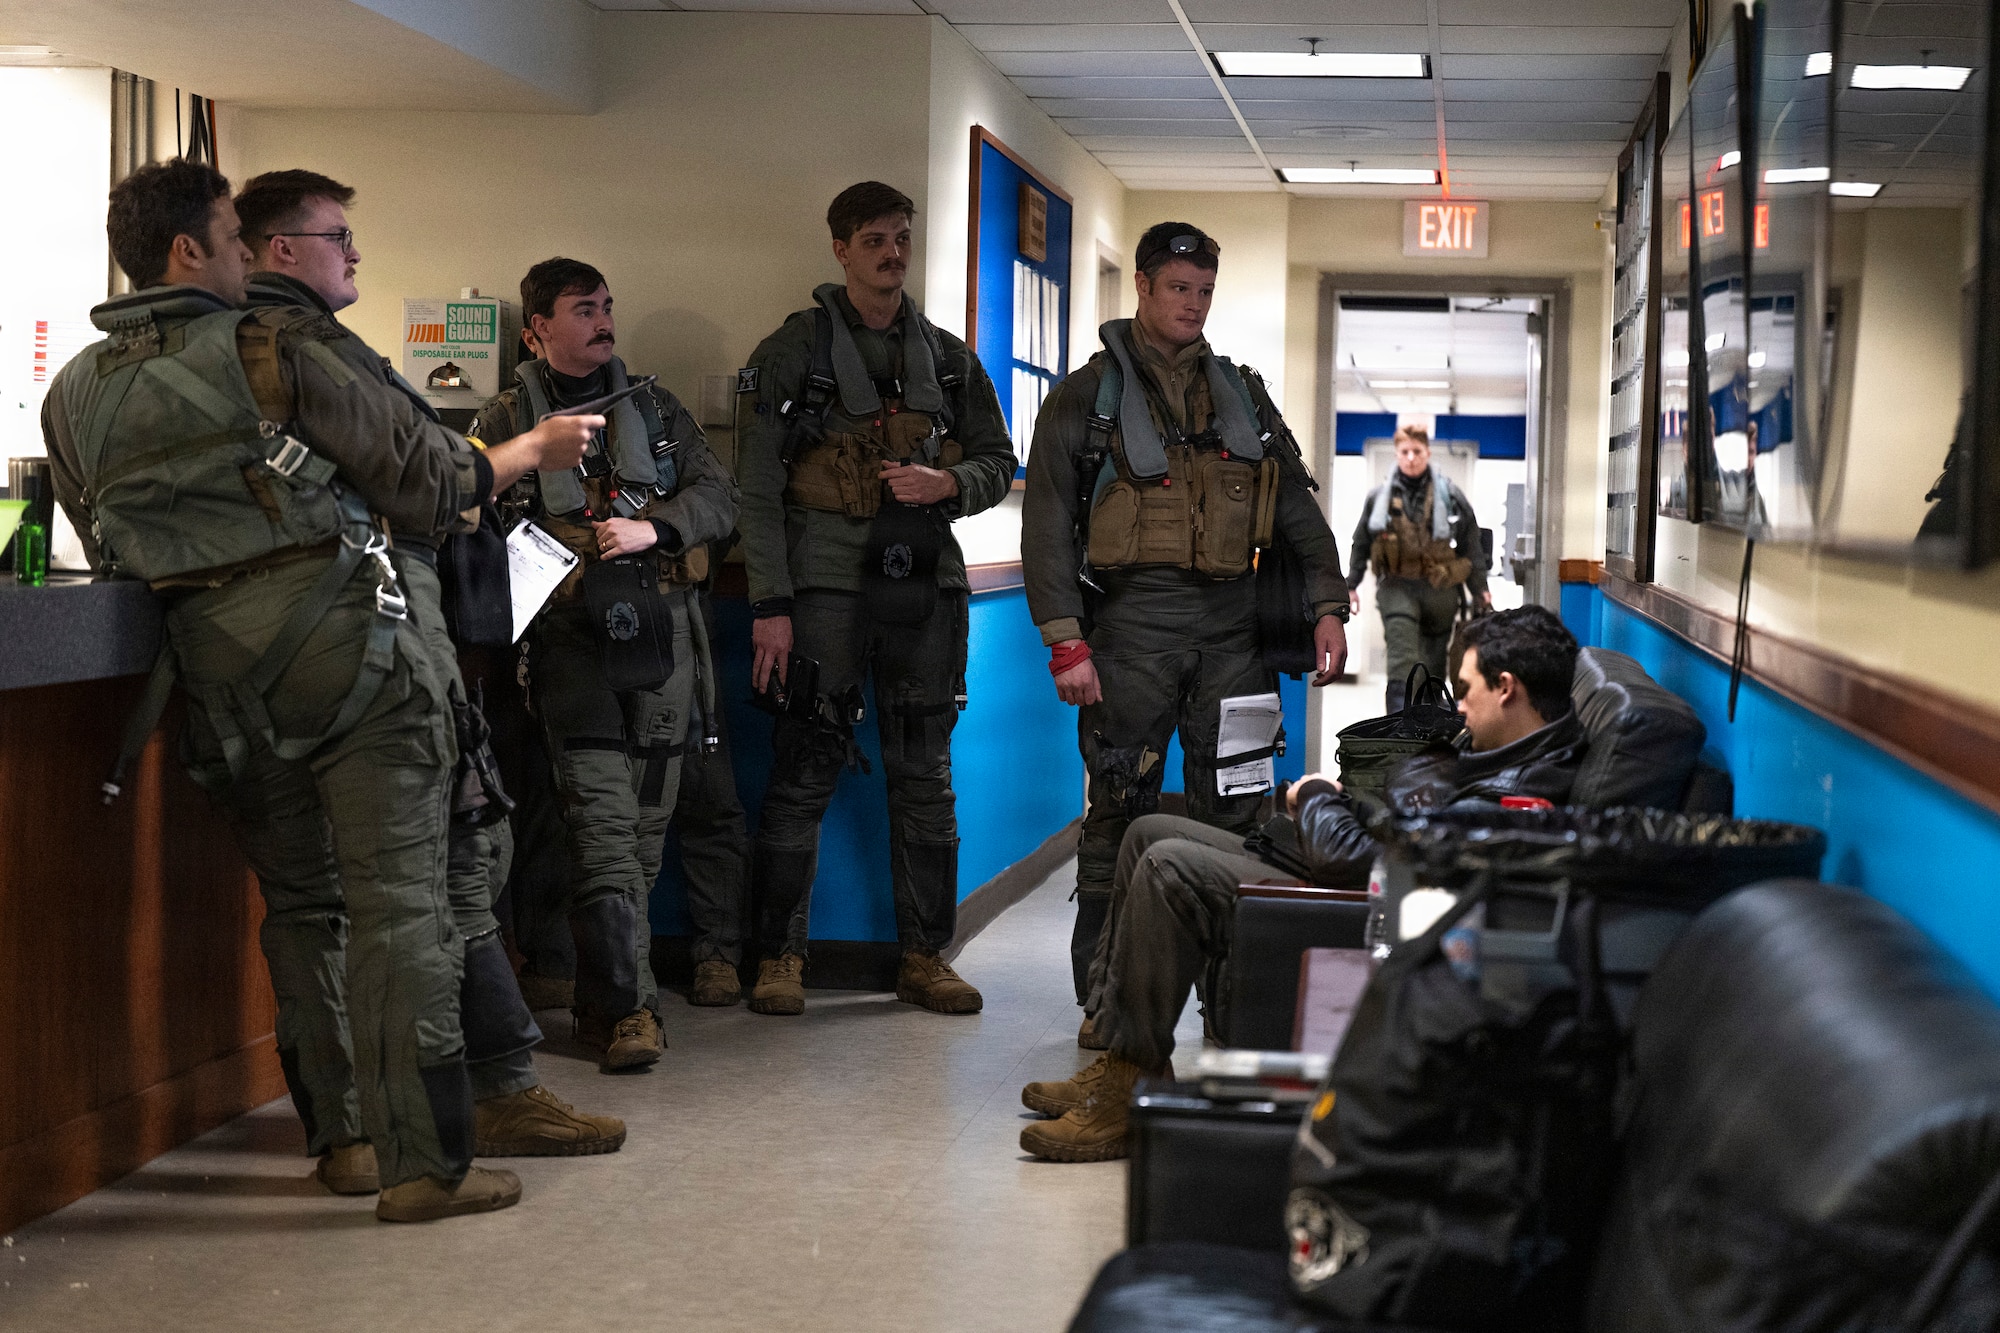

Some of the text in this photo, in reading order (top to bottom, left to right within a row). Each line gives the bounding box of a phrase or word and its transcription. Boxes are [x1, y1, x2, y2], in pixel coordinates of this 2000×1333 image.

[1420, 205, 1477, 249] EXIT
[448, 306, 491, 323] SOUND
[448, 324, 491, 341] GUARD
[412, 350, 488, 359] DISPOSABLE EAR PLUGS
